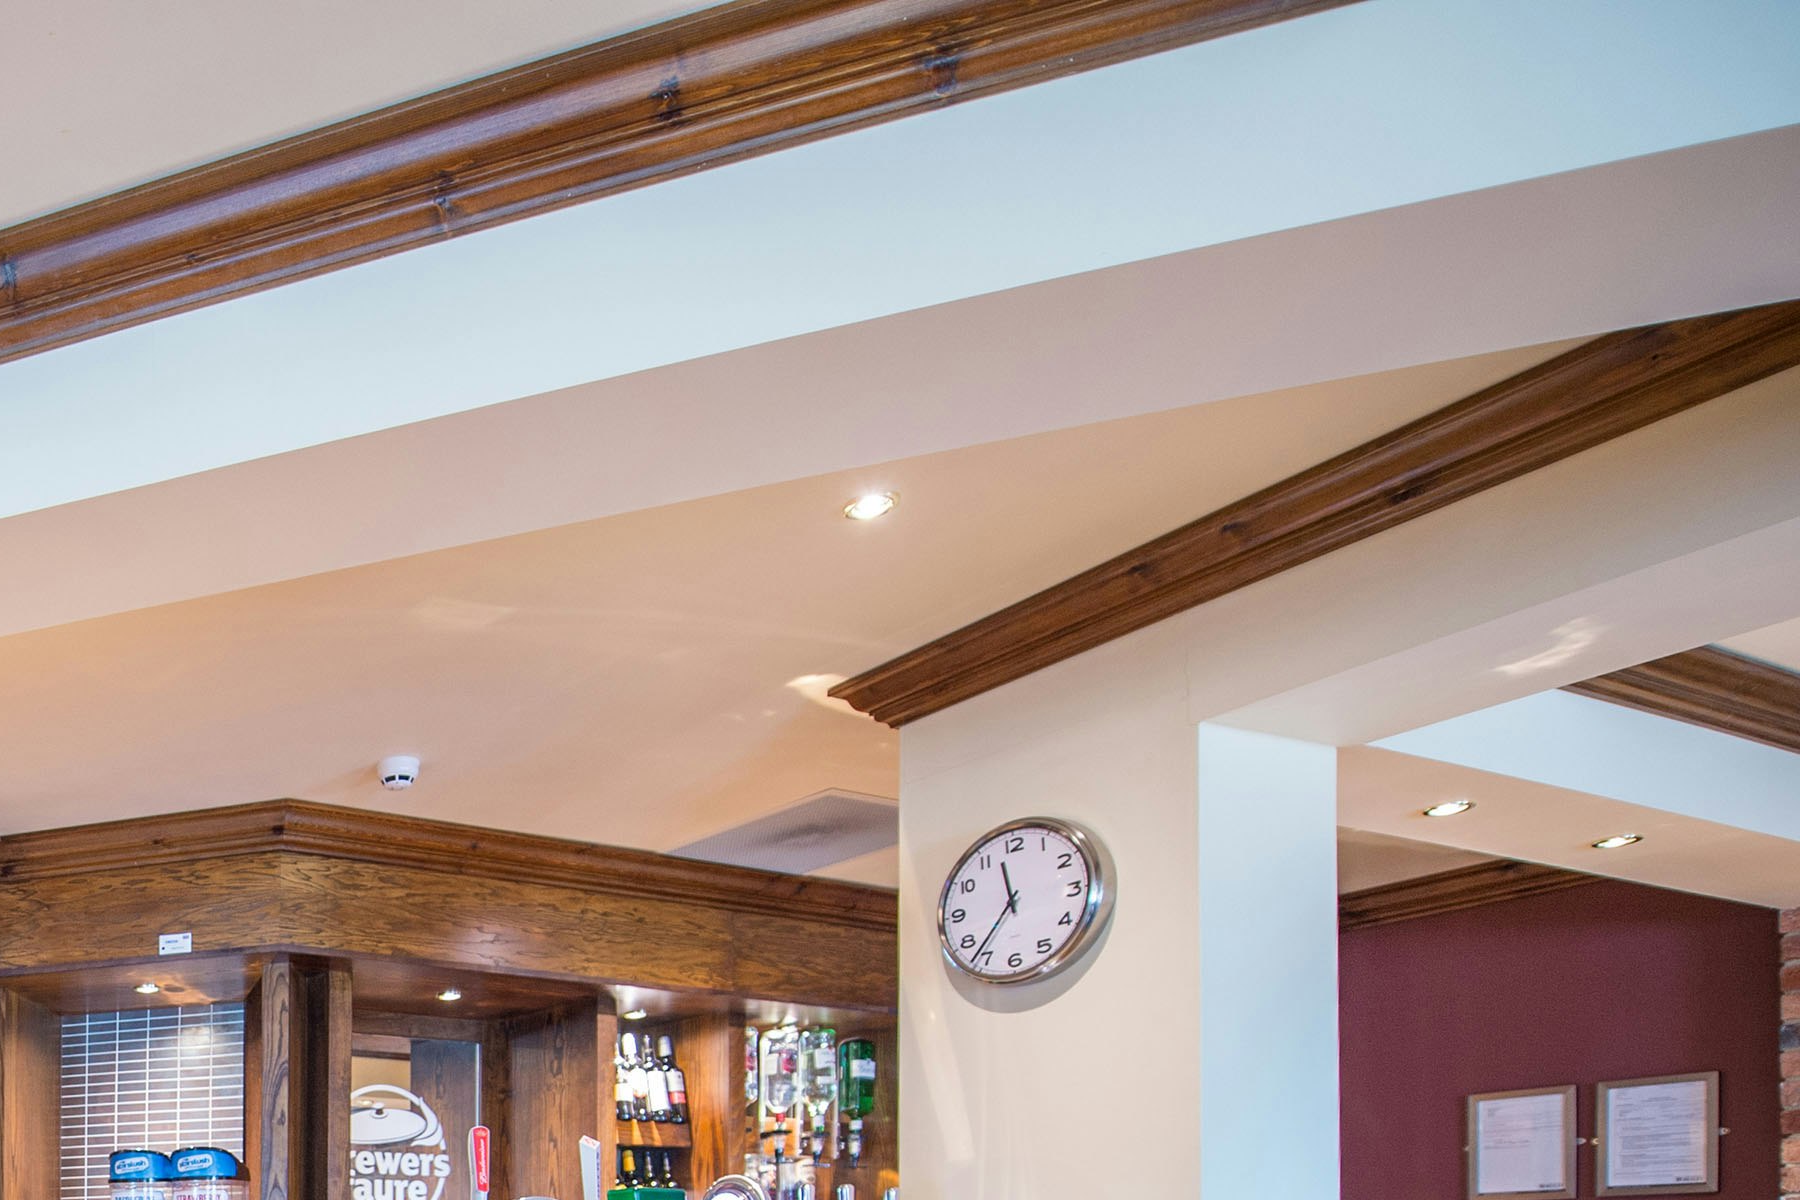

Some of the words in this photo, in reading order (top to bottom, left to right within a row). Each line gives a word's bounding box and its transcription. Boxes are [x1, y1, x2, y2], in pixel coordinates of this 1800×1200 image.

[1005, 837, 1025, 854] 12
[1041, 837, 1046, 851] 1
[980, 855, 991, 870] 11
[1057, 853, 1072, 869] 2
[961, 879, 975, 894] 10
[1066, 880, 1082, 897] 3
[951, 909, 966, 923] 9
[1058, 911, 1073, 926] 4
[960, 934, 976, 949] 8
[1036, 938, 1052, 954] 5
[981, 951, 993, 966] 7
[1008, 953, 1023, 968] 6
[350, 1150, 451, 1178] ewers
